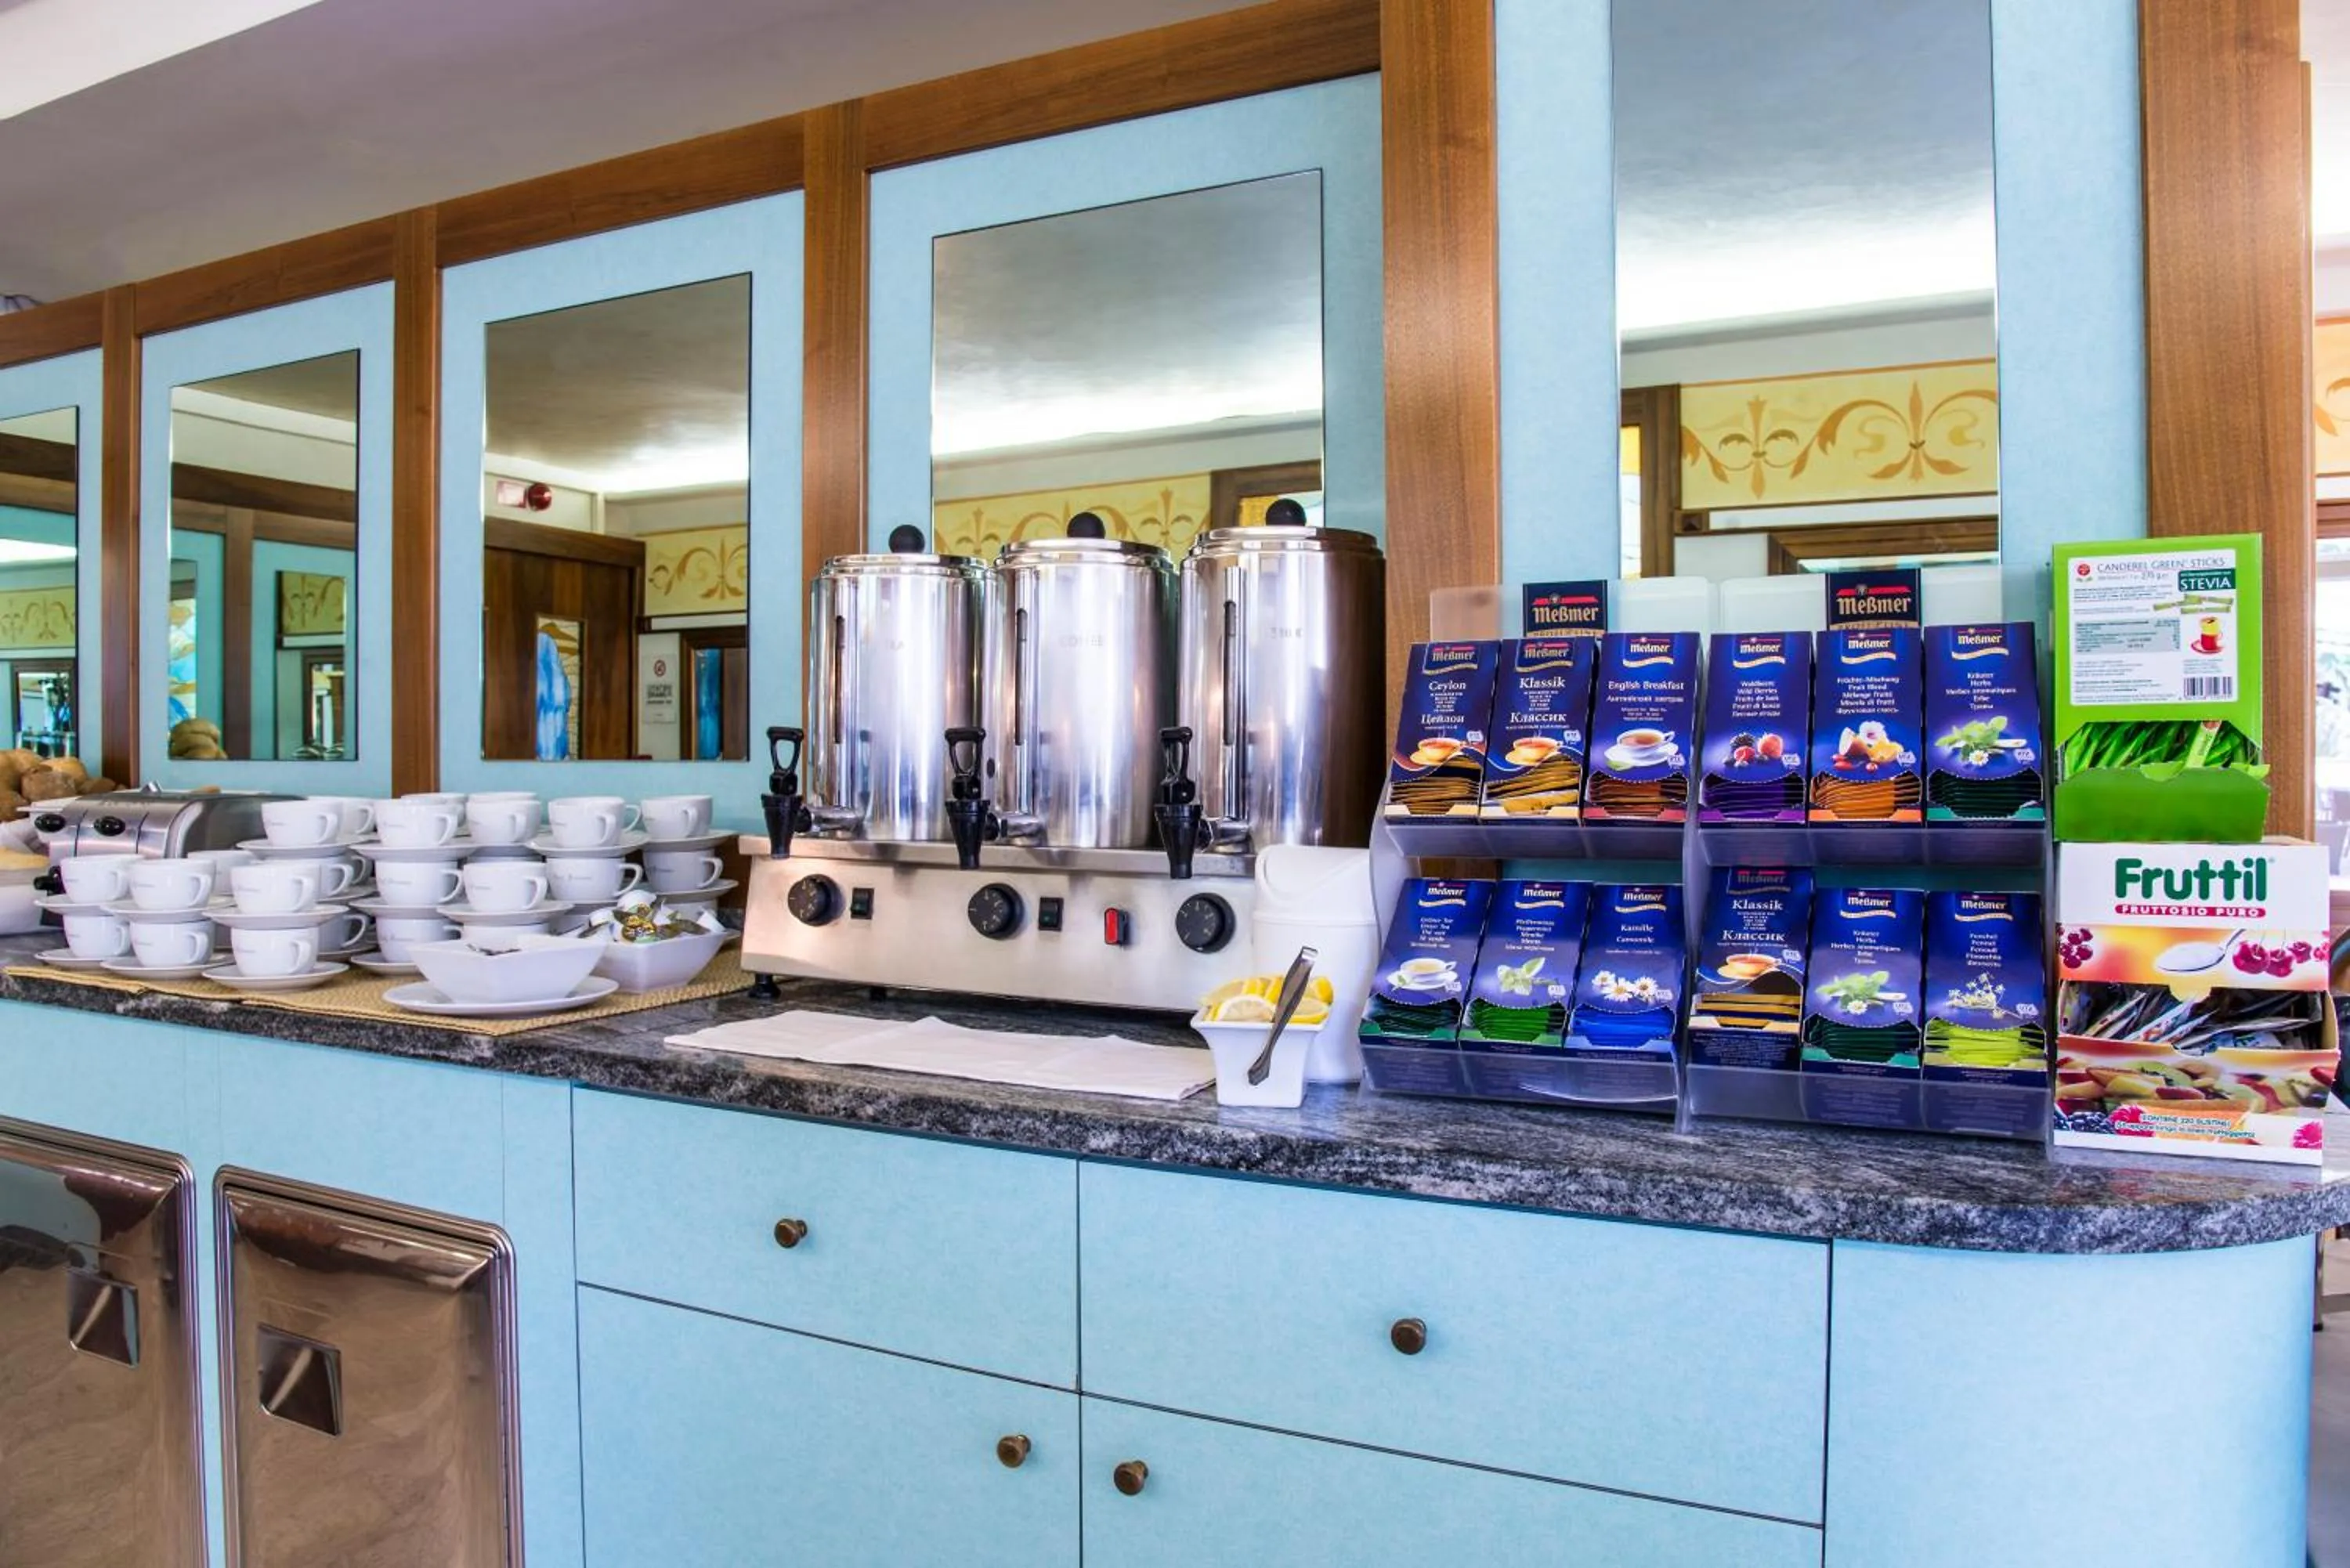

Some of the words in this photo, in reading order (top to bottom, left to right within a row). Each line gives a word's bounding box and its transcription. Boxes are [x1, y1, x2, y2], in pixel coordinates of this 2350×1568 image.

[2097, 561, 2148, 573] CANDEREL
[2189, 557, 2226, 568] STICKS
[2180, 576, 2232, 590] STEVIA
[1836, 597, 1911, 615] Meßmer
[1532, 605, 1599, 623] Meßmer
[1848, 640, 1891, 649] Meßmer
[1958, 634, 2002, 645] Meßmer
[1524, 647, 1569, 659] Meßmer
[1740, 644, 1781, 654] Meßmer
[1432, 650, 1475, 662] Meßmer
[1428, 680, 1466, 692] Ceylon
[1519, 676, 1566, 688] Klassik
[1608, 681, 1640, 692] English
[1643, 681, 1684, 690] Breakfast
[1510, 711, 1567, 724] Классик
[2115, 857, 2267, 901] Fruttil
[1732, 899, 1783, 910] Klassik
[1847, 896, 1891, 907] Meßmer
[1961, 900, 2007, 909] Meßmer
[2121, 905, 2208, 916] FRUTTOSIO
[2216, 907, 2258, 917] PURO
[1621, 924, 1654, 933] Kamille
[1723, 930, 1785, 941] Классик
